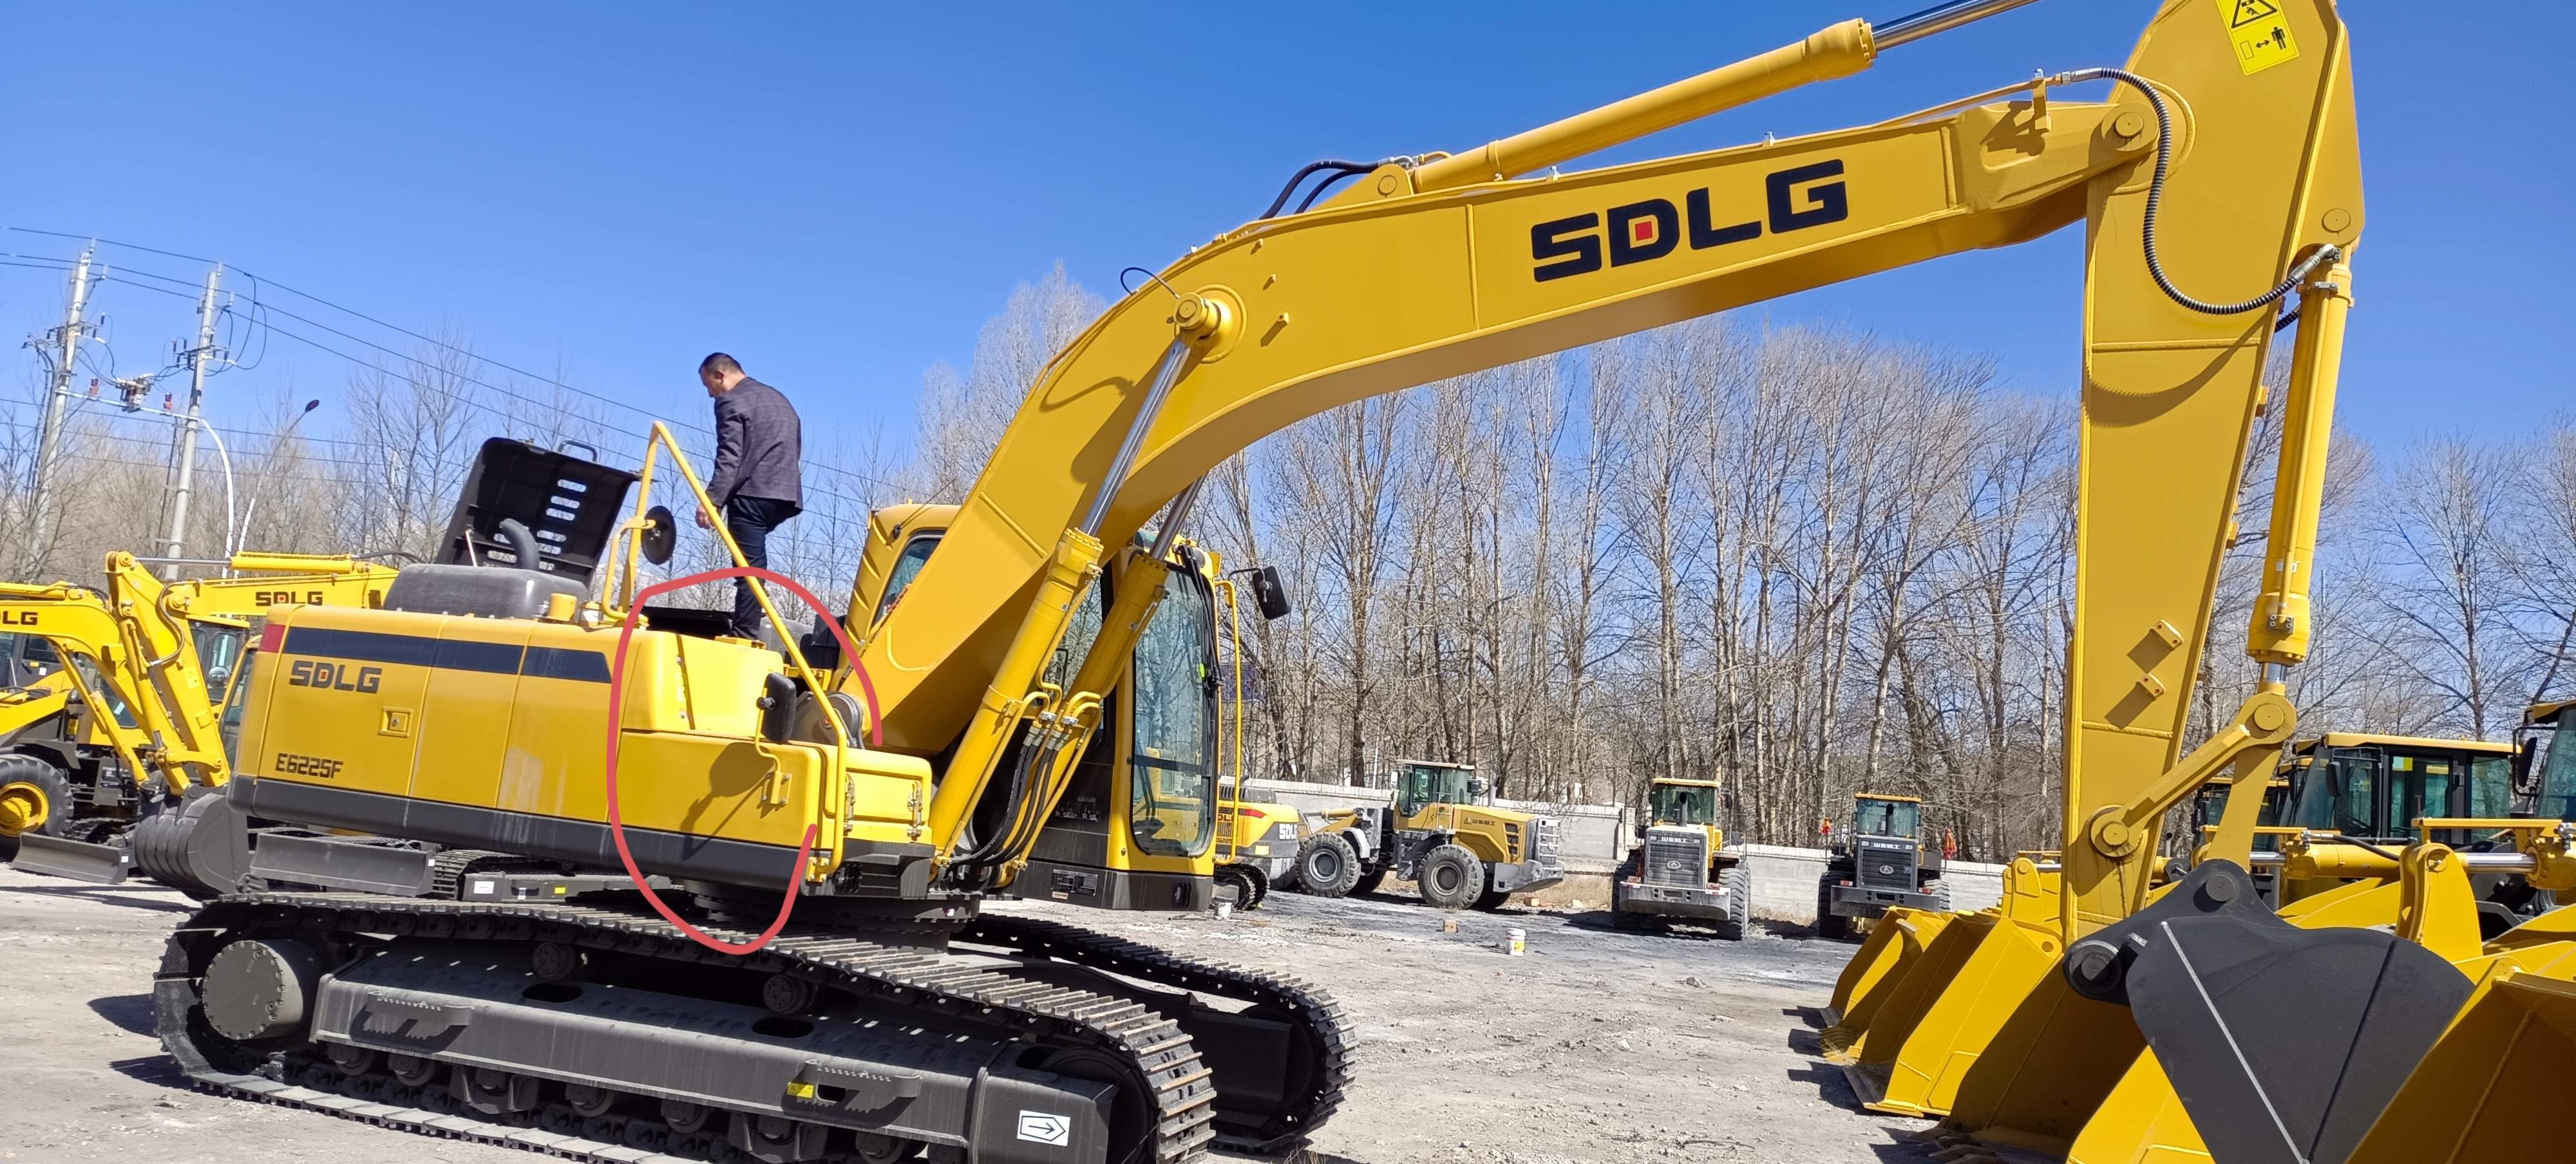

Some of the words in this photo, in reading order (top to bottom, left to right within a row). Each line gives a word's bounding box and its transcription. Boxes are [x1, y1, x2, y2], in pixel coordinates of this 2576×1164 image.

[1531, 159, 1848, 283] SDLG
[256, 592, 323, 606] SDLG
[0, 610, 38, 626] LG
[289, 660, 382, 694] SDLG
[276, 753, 343, 778] E6225F
